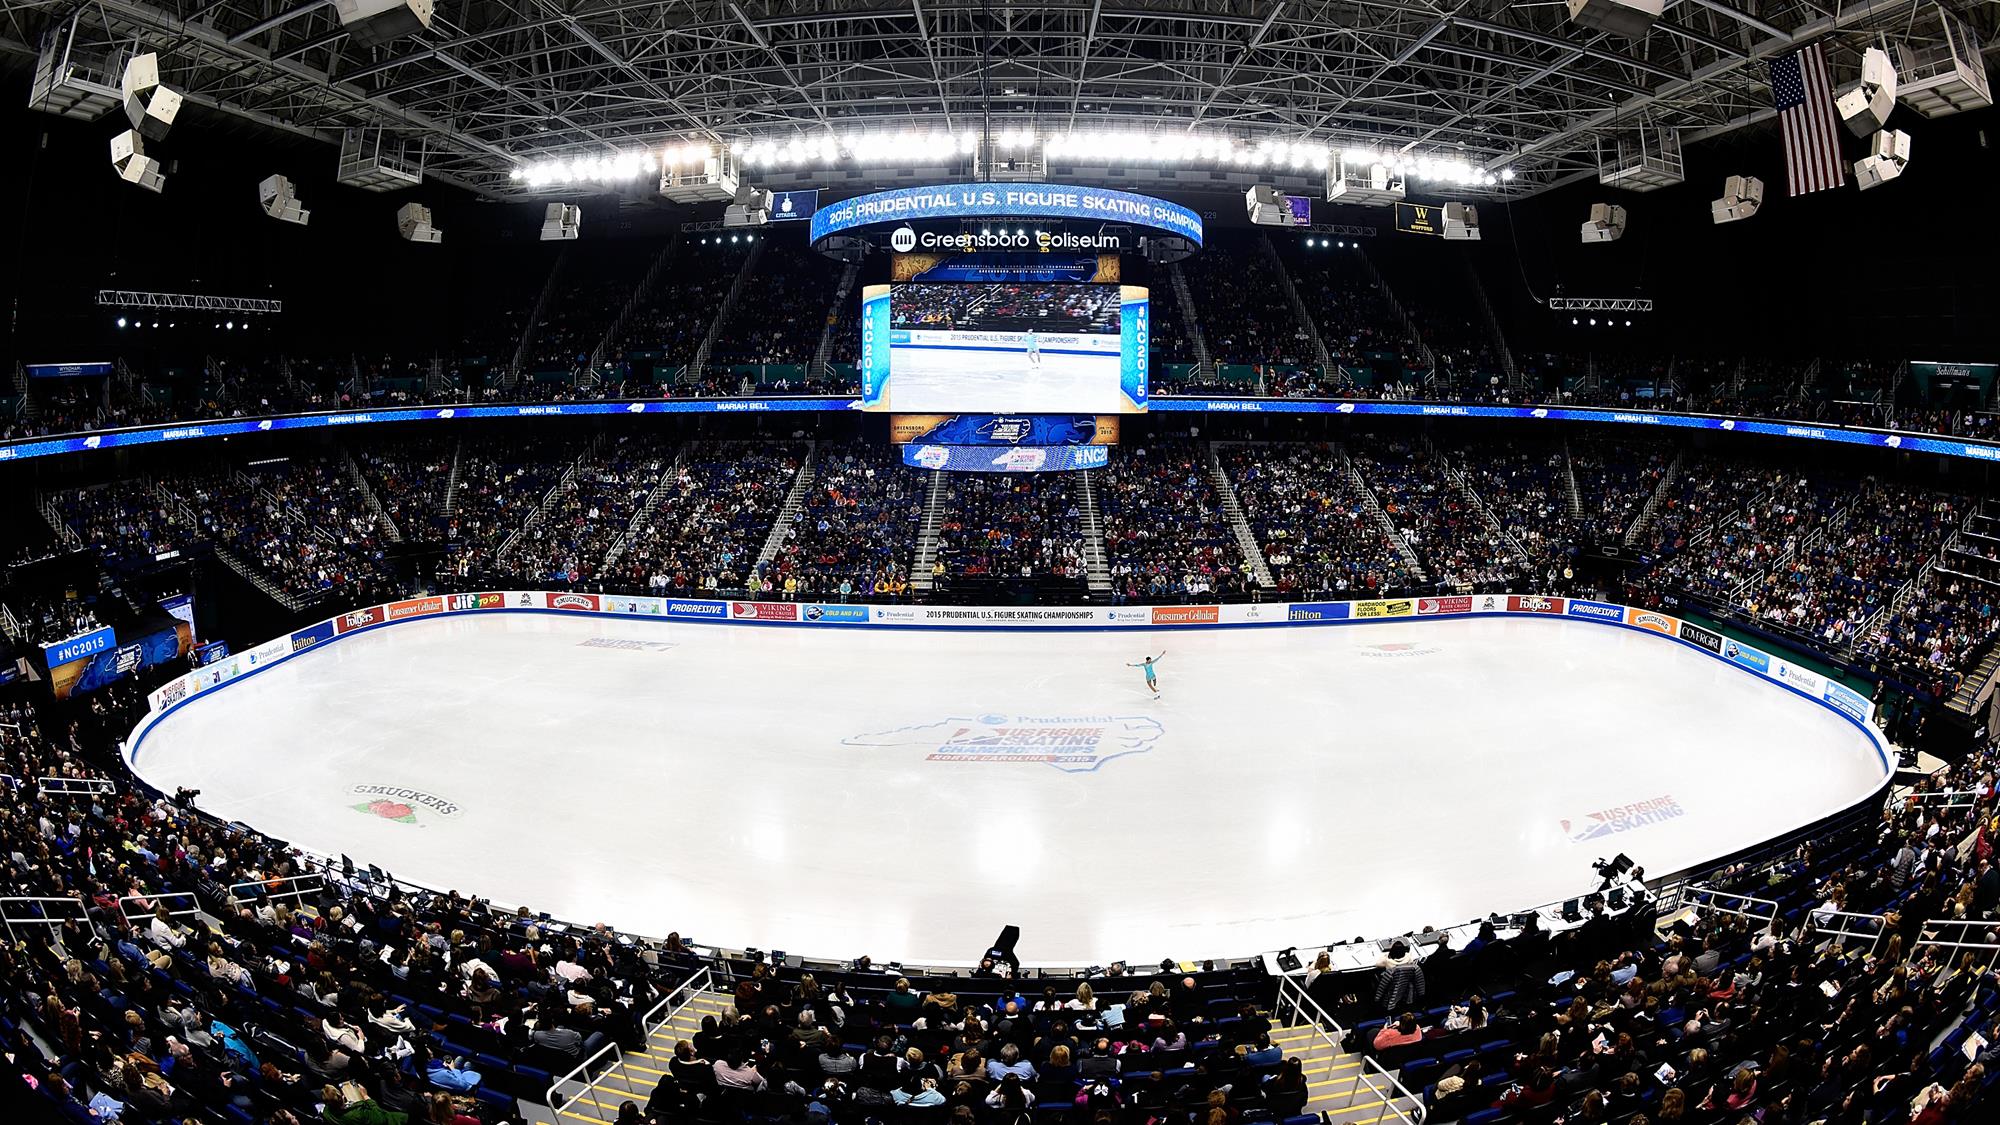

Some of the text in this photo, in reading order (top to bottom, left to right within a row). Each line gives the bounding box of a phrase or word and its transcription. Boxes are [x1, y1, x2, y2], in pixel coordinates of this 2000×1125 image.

[829, 207, 853, 224] 2015
[856, 193, 956, 217] PRUDENTIAL
[963, 192, 1000, 206] U.S.
[1006, 192, 1077, 207] FIGURE
[1083, 196, 1150, 216] SKATING
[1415, 207, 1428, 219] W
[921, 231, 1120, 247] Greensboro Coliseum
[864, 304, 874, 395] #NC2015
[1136, 306, 1146, 397] #NC2015
[1936, 365, 1970, 376] Schiffman's
[1452, 407, 1468, 415] BELL
[328, 416, 352, 424] MARIAH
[1615, 414, 1660, 423] MARIAH BELL
[163, 428, 204, 439] MARIAH BELL
[1786, 427, 1826, 438] MARIAH BELL
[1965, 446, 1994, 457] MARIAH
[452, 595, 476, 609] Jif
[670, 603, 723, 614] PROGRESSIVE
[762, 604, 791, 612] VIKING
[1519, 597, 1551, 611] Folgers
[389, 601, 441, 617] Consumer Cellular
[994, 611, 1016, 619] FIGURE
[1017, 611, 1043, 619] SKATING
[1152, 609, 1217, 621] Consumer Cellular
[1289, 610, 1321, 620] Hilton
[1571, 603, 1621, 618] PROGRESSIVE
[346, 613, 374, 628] Folgers
[293, 636, 316, 651] Hilton
[1681, 626, 1719, 650] COVERGIRL
[58, 637, 104, 661] #NC2015
[259, 643, 284, 659] Prudential
[1788, 670, 1816, 688] Prudential
[1017, 715, 1113, 724] Prudential
[1008, 728, 1105, 736] US FIGURE
[1001, 736, 1101, 745] SKATING
[938, 745, 1096, 753] CHAMPIONSHIPS
[354, 785, 459, 814] SMUCKER'S
[1603, 794, 1676, 820] US FIGURE
[1611, 804, 1684, 832] SKATING
